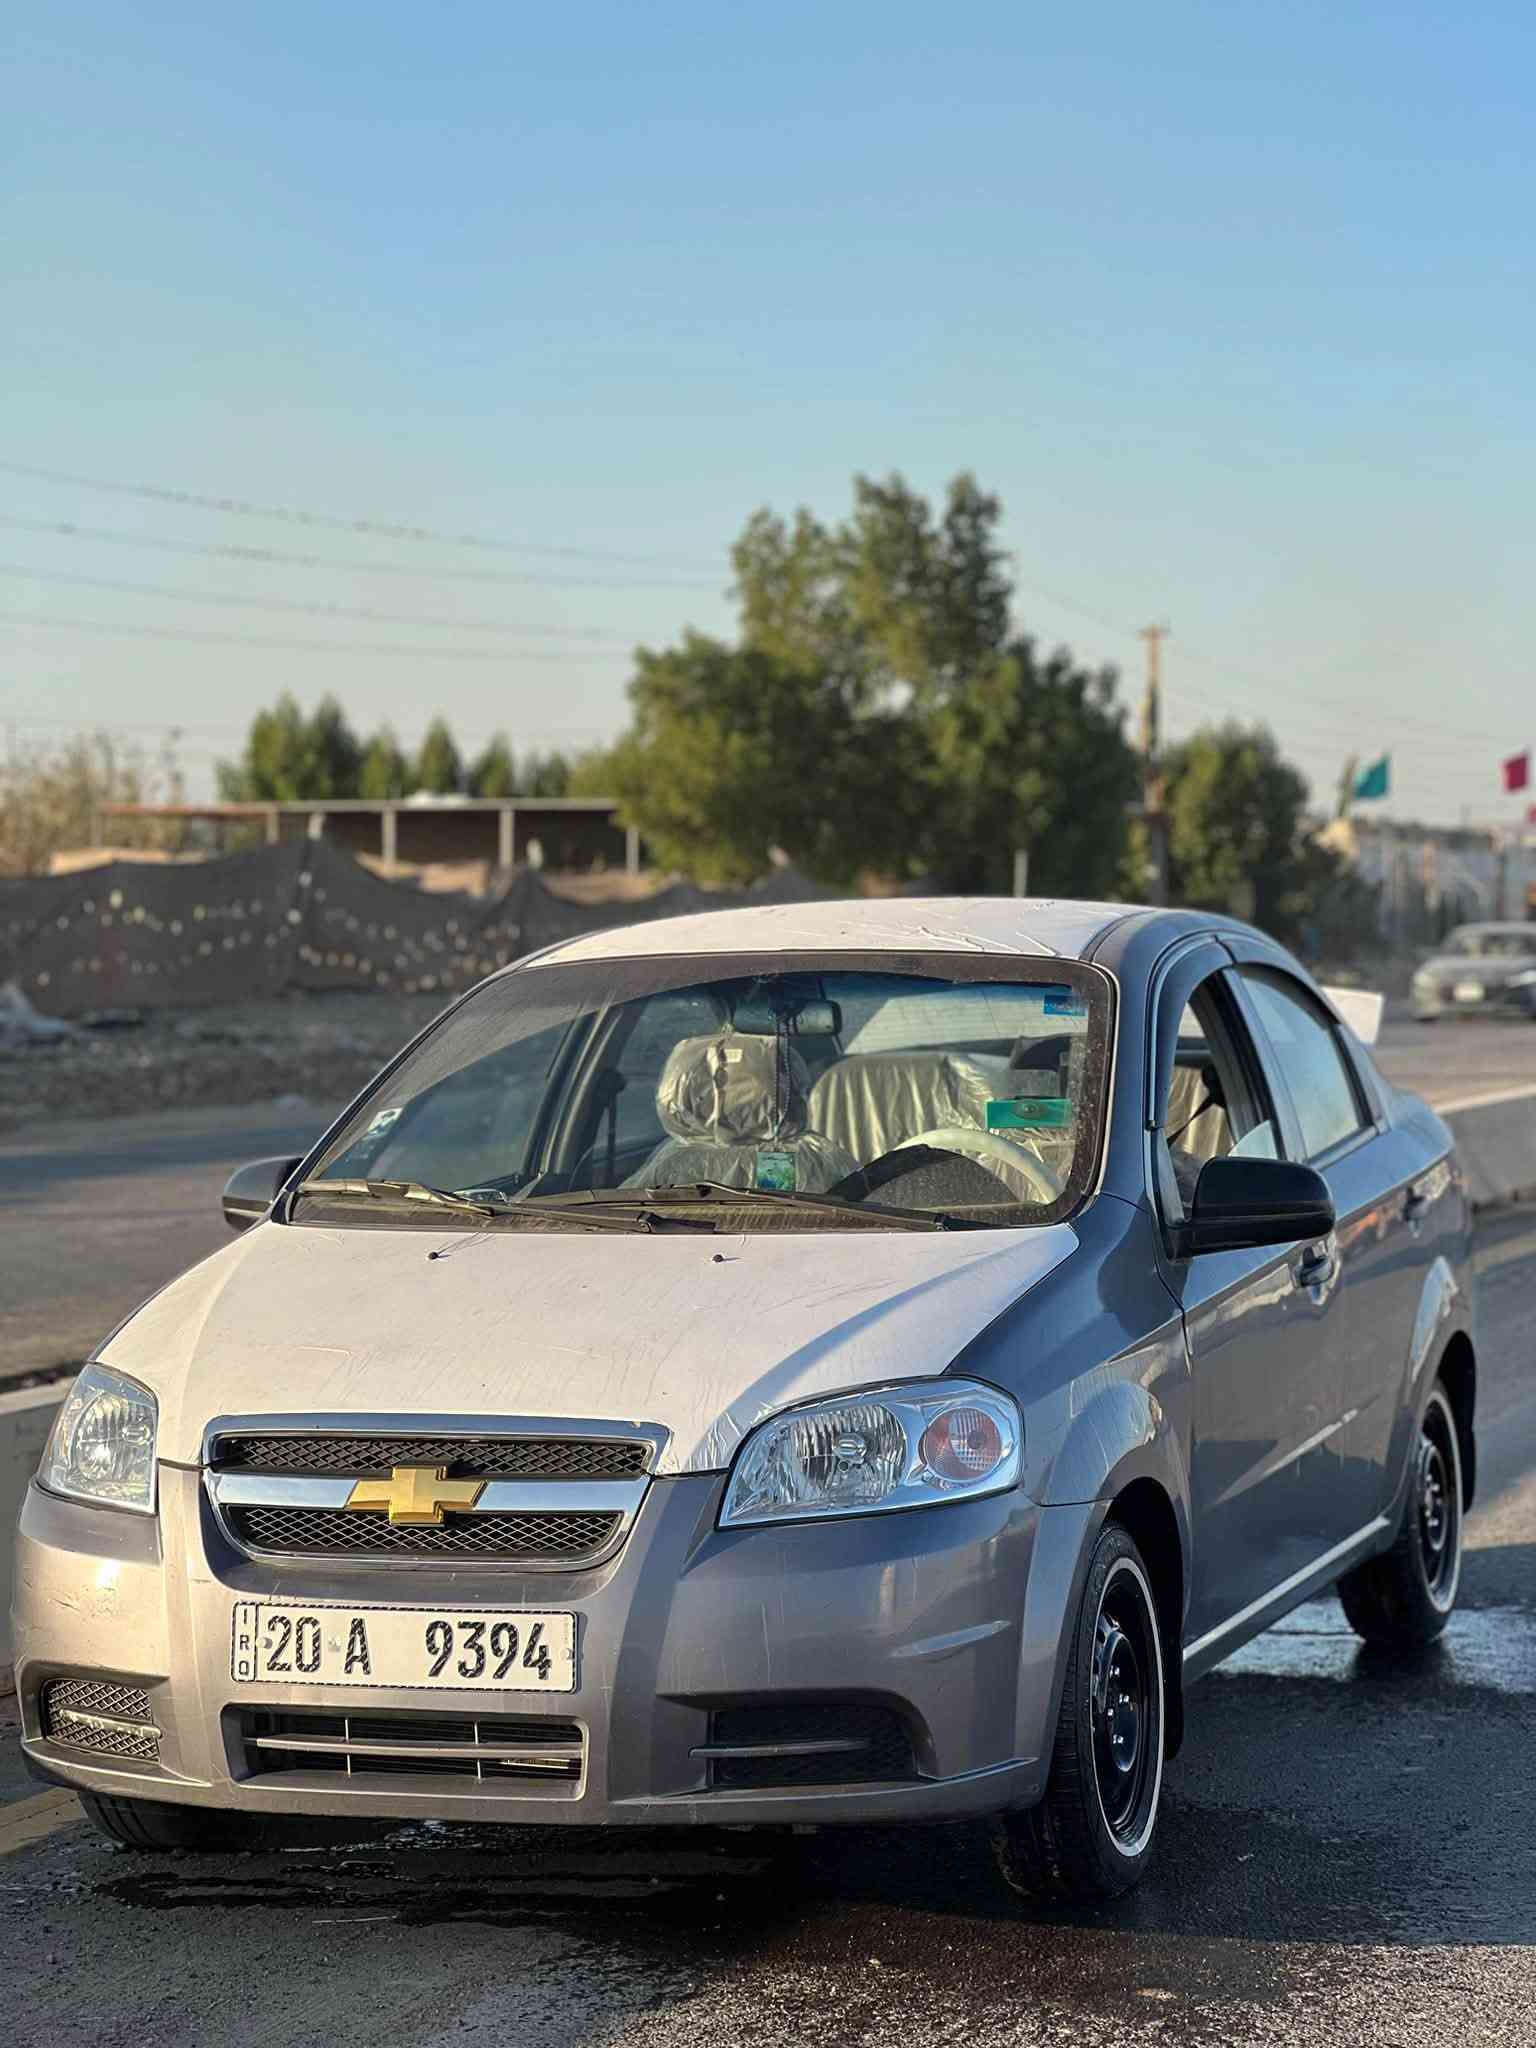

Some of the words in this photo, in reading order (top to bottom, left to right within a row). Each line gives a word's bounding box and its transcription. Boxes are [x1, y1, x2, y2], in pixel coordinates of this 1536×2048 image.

[266, 1615, 321, 1673] 20
[344, 1617, 371, 1675] A
[425, 1620, 551, 1680] 9394
